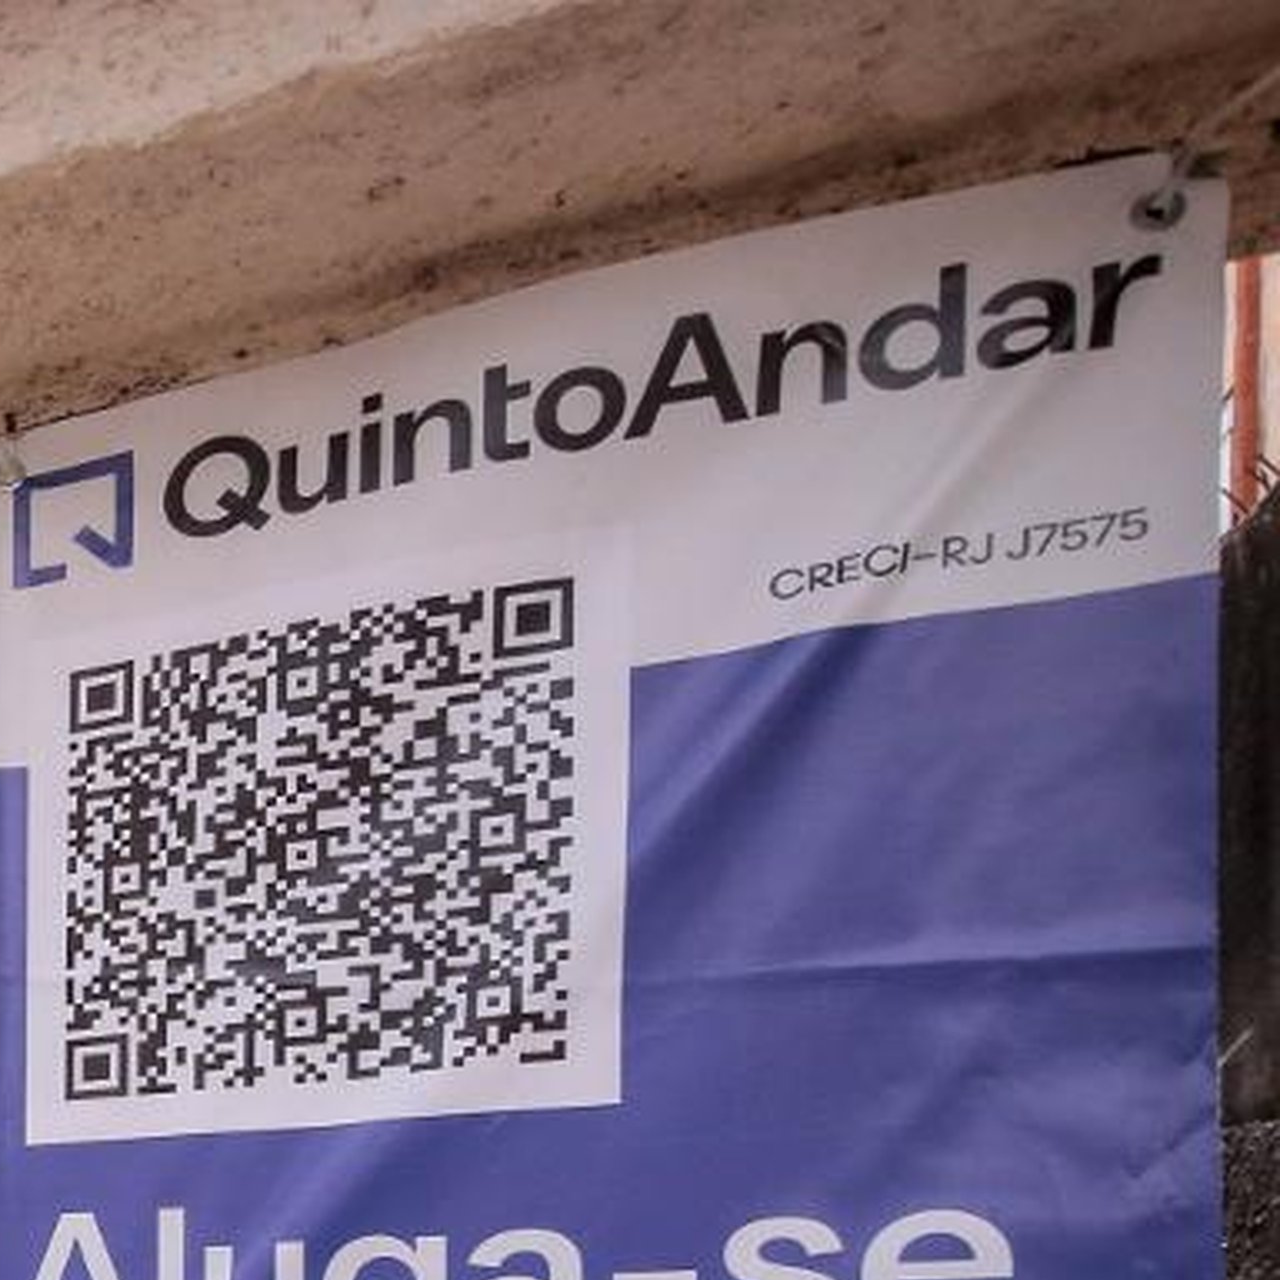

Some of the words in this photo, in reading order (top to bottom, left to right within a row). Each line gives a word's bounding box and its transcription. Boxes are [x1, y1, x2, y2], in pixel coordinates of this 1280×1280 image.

[163, 246, 1163, 538] QuintoAndar
[769, 532, 995, 601] CRECI-RJ
[1006, 506, 1151, 561] J7575
